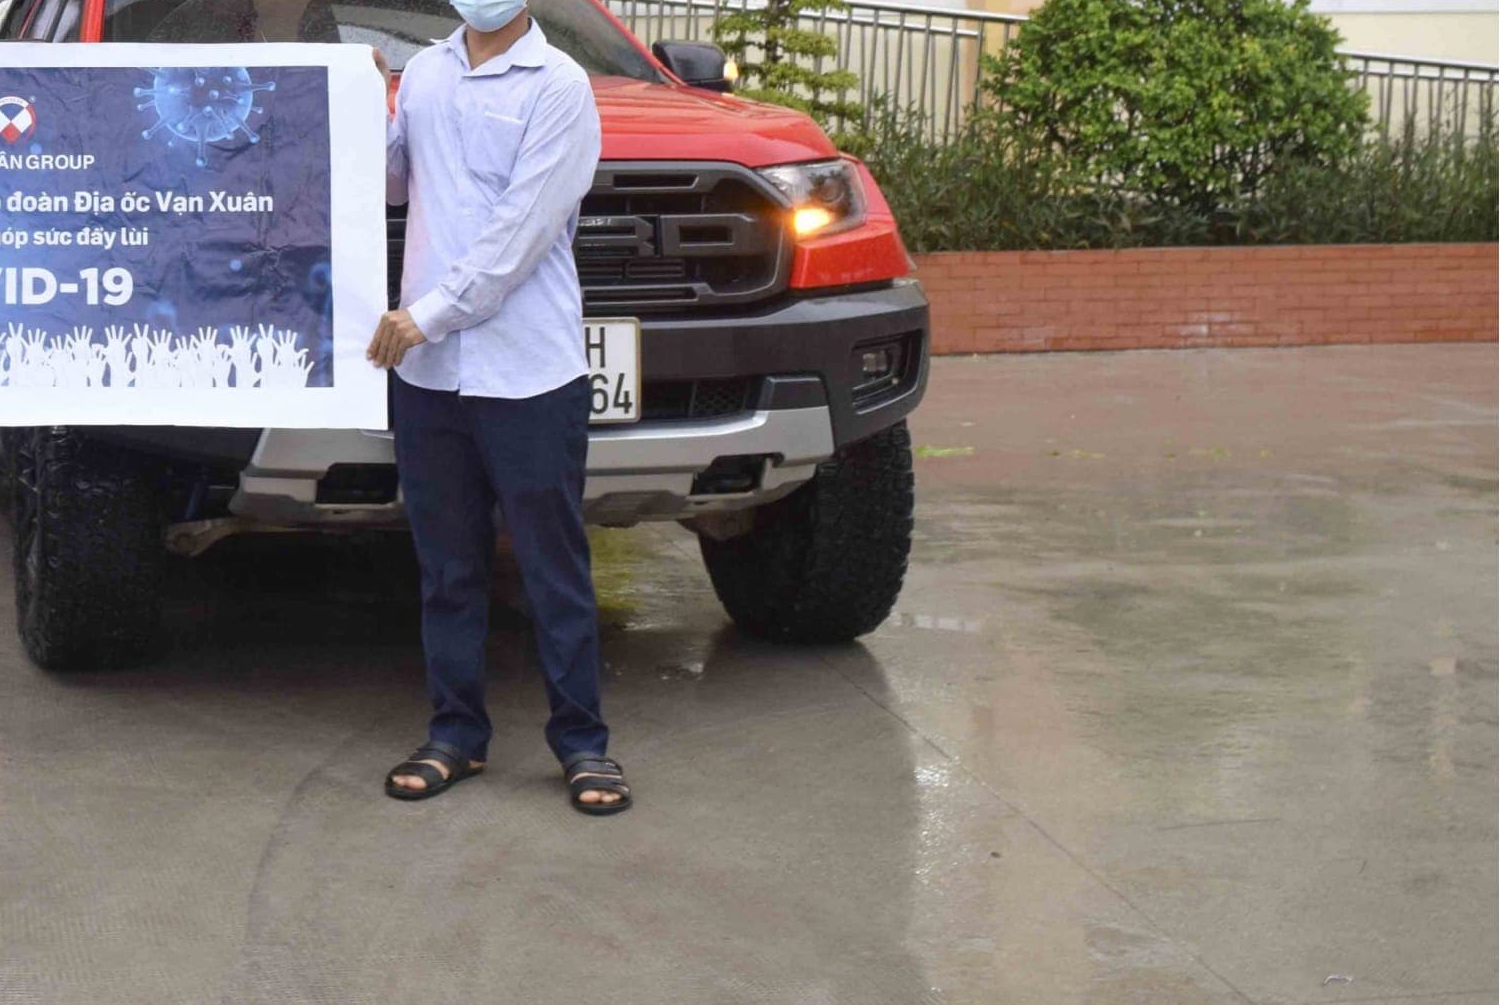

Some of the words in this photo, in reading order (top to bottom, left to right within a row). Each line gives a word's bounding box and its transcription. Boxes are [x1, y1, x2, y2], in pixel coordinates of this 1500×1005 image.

[26, 154, 95, 170] GROUP
[7, 190, 68, 213] đoàn
[74, 190, 114, 217] Địa
[120, 188, 150, 213] ốc
[155, 190, 203, 217] Vạn
[208, 190, 274, 213] Xuân
[33, 226, 72, 246] sức
[76, 226, 116, 250] đẩy
[120, 226, 149, 246] lùi
